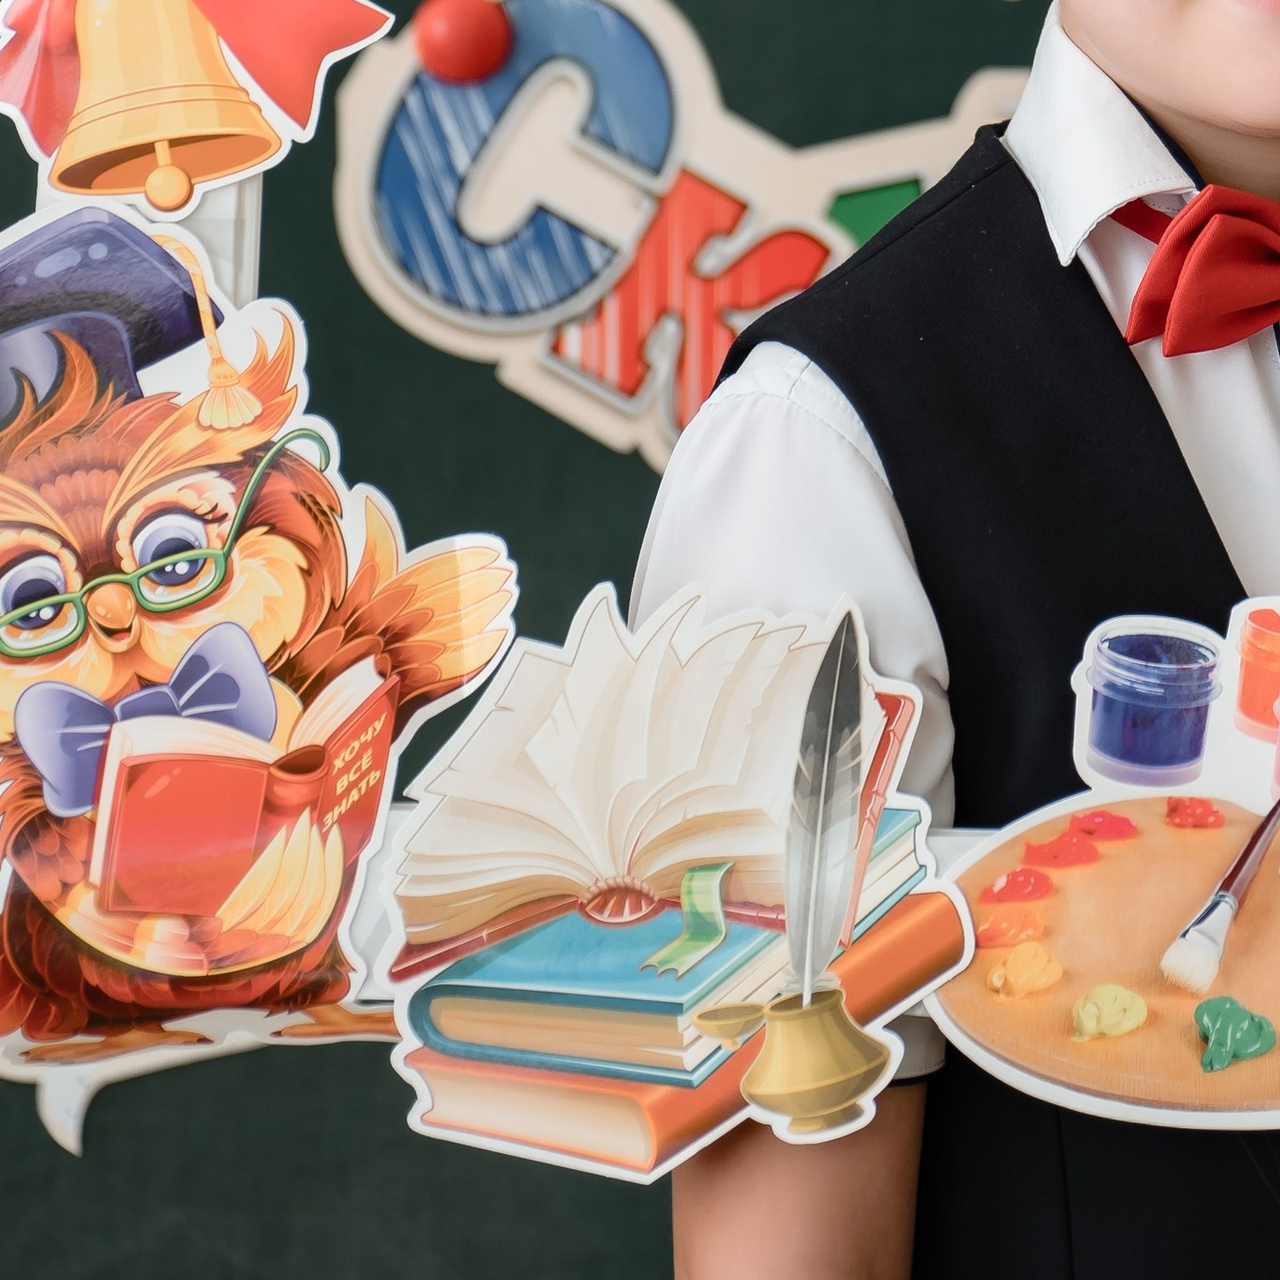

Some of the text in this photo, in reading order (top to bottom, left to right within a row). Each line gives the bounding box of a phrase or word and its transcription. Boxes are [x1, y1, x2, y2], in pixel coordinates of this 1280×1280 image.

[332, 712, 387, 776] ХОЧУ
[336, 748, 374, 796] ВСЁ
[322, 769, 381, 834] ЗНАТЬ
